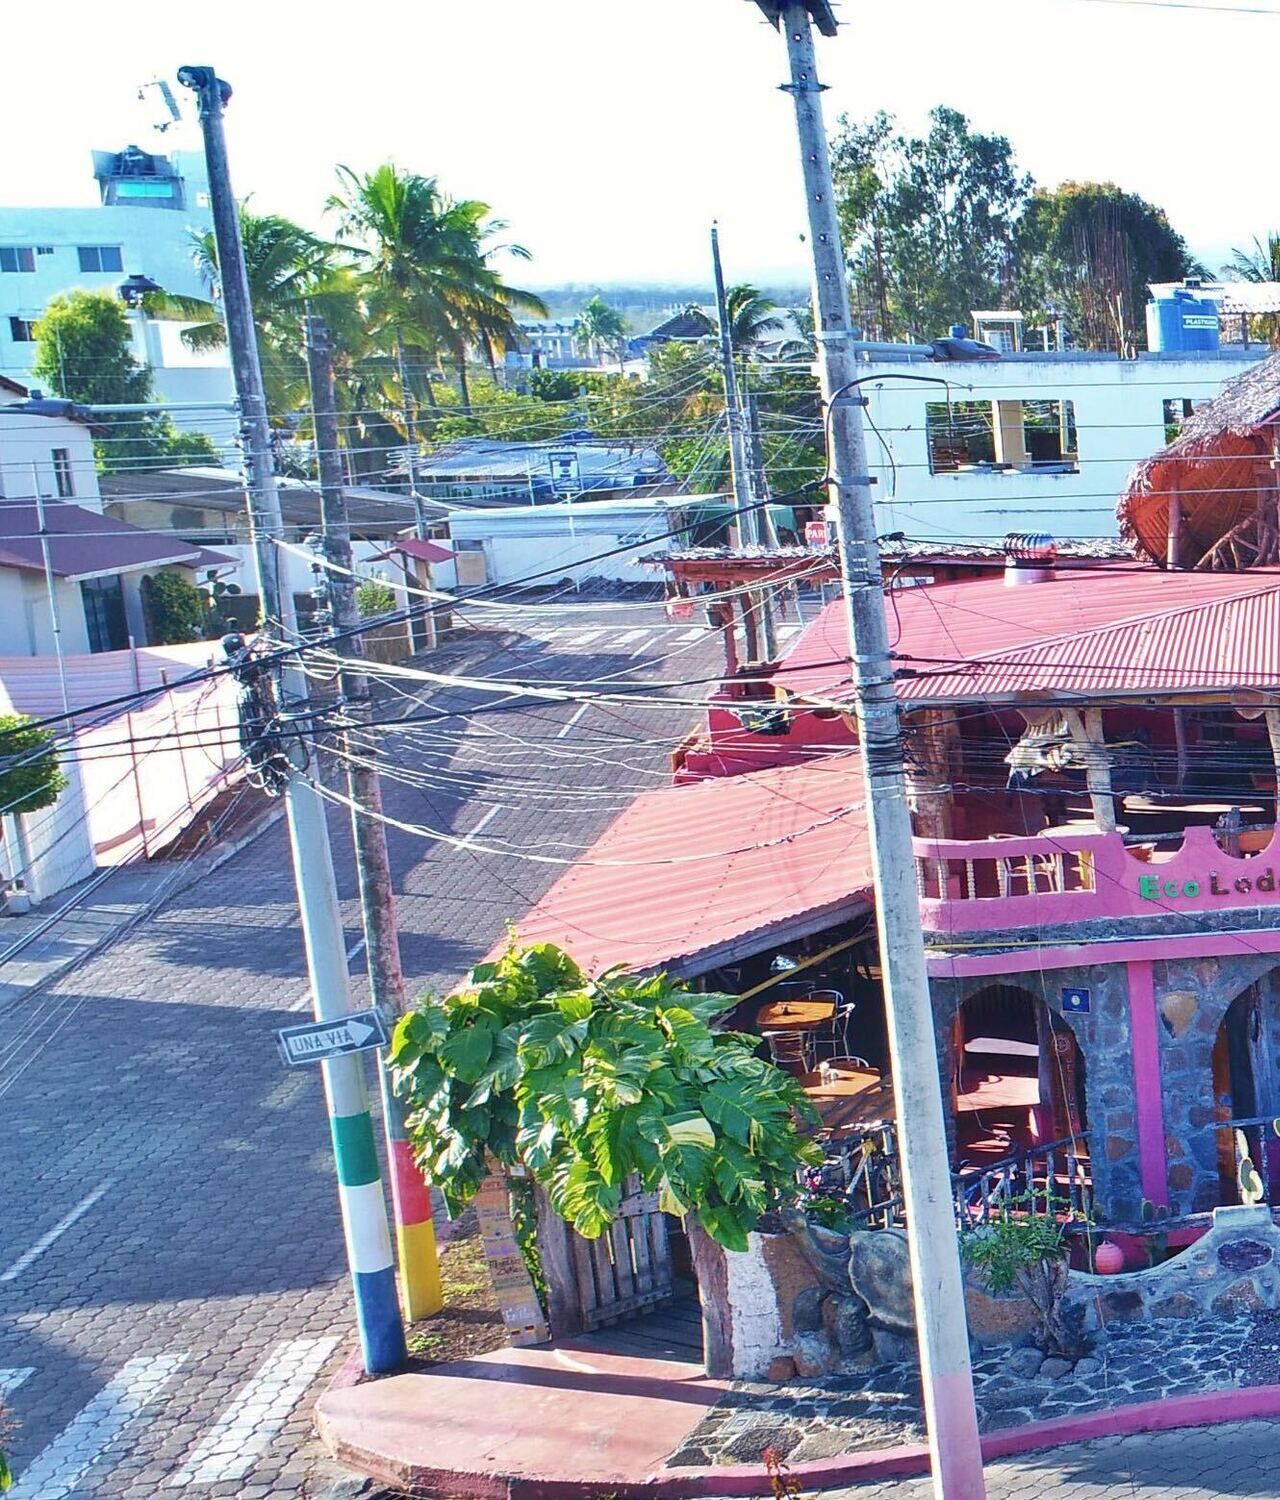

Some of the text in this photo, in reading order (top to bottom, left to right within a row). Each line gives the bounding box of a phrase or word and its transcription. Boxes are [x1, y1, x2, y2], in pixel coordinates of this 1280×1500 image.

[1138, 875, 1200, 900] Eco
[294, 1029, 354, 1051] UNA VIA
